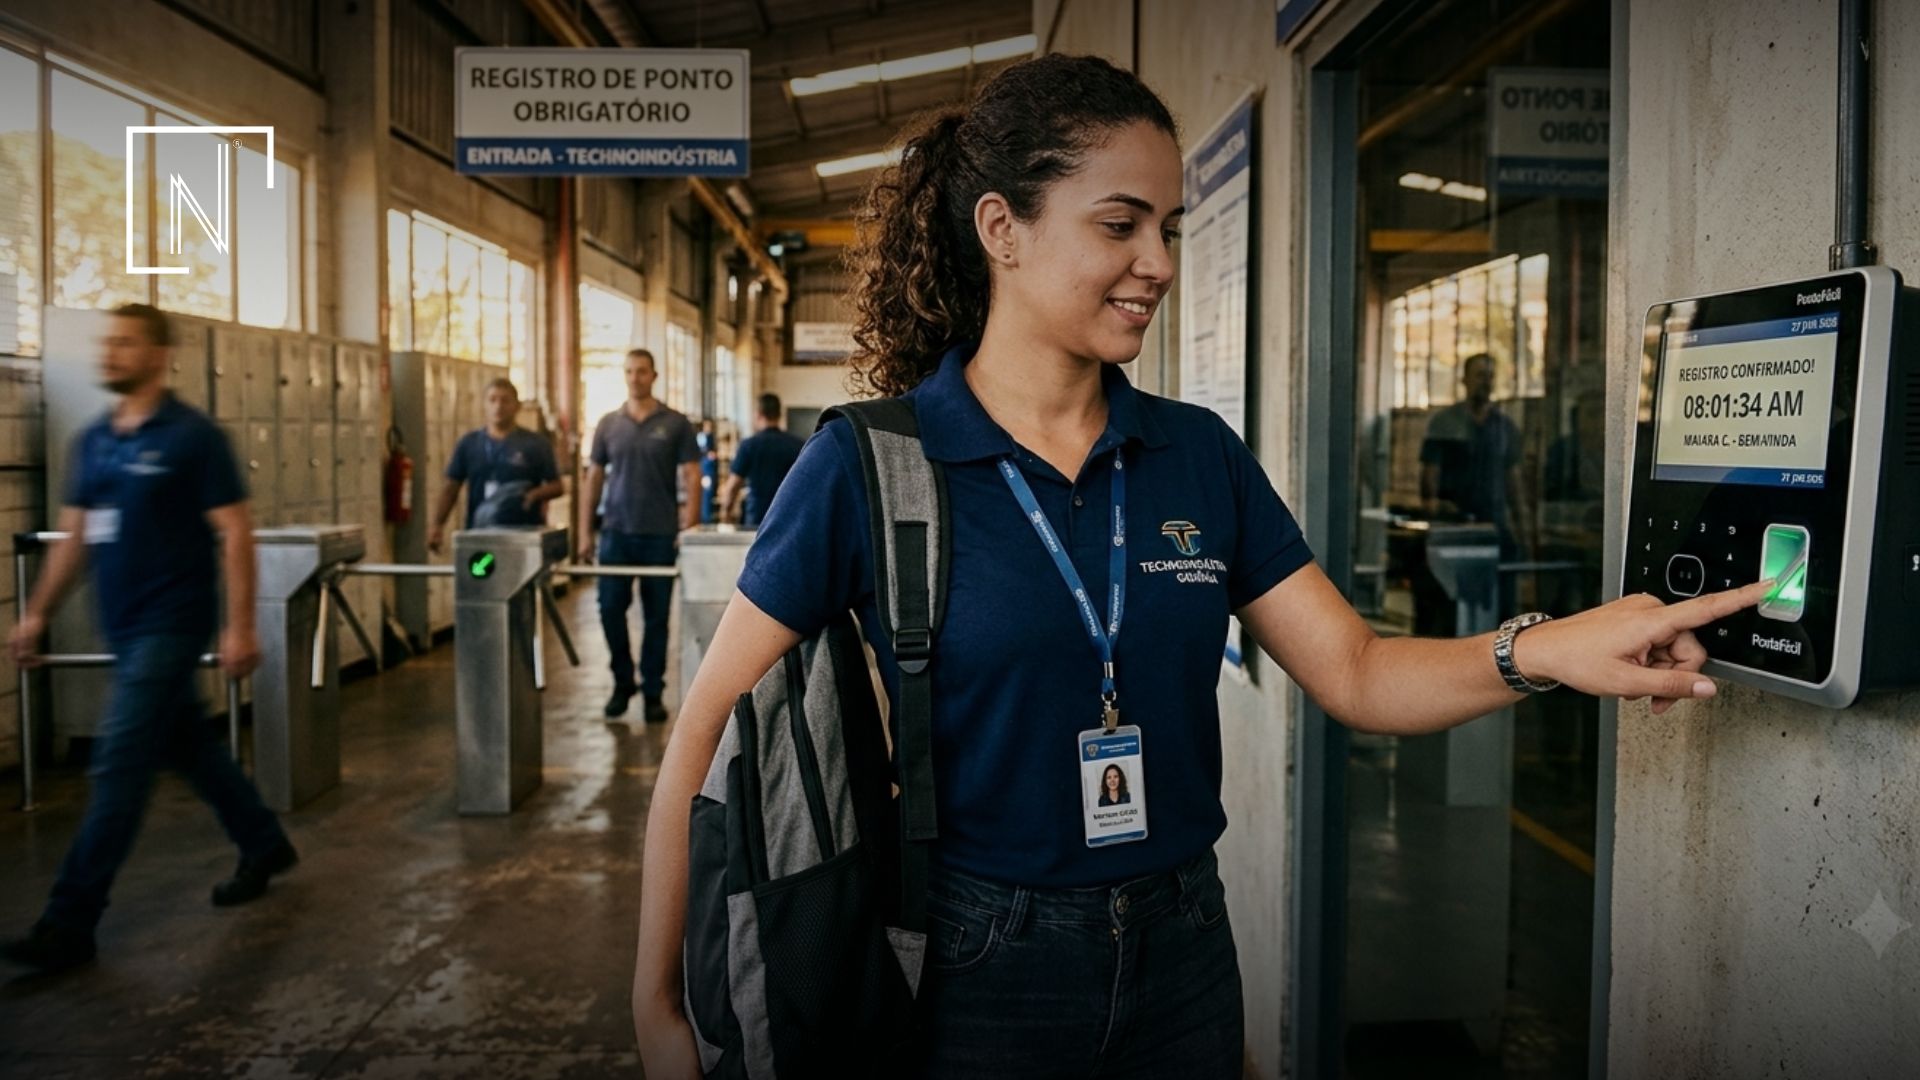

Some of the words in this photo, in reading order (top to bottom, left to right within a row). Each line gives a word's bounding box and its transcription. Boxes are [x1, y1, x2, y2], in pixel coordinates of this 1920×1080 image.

[471, 67, 596, 89] REGISTRO
[604, 68, 636, 89] DE
[645, 69, 733, 90] PONTO
[514, 98, 690, 122] OBRIGATÓRIO
[467, 147, 554, 165] ENTRADA
[566, 145, 737, 166] TECHNOINDÚSTRIA
[1679, 365, 1728, 382] REGISTRO
[1731, 358, 1815, 379] CONFIRMADO!
[1684, 392, 1762, 419] 08:01:34
[1767, 389, 1804, 416] AM
[1673, 520, 1679, 530] 2
[1700, 522, 1706, 533] 3
